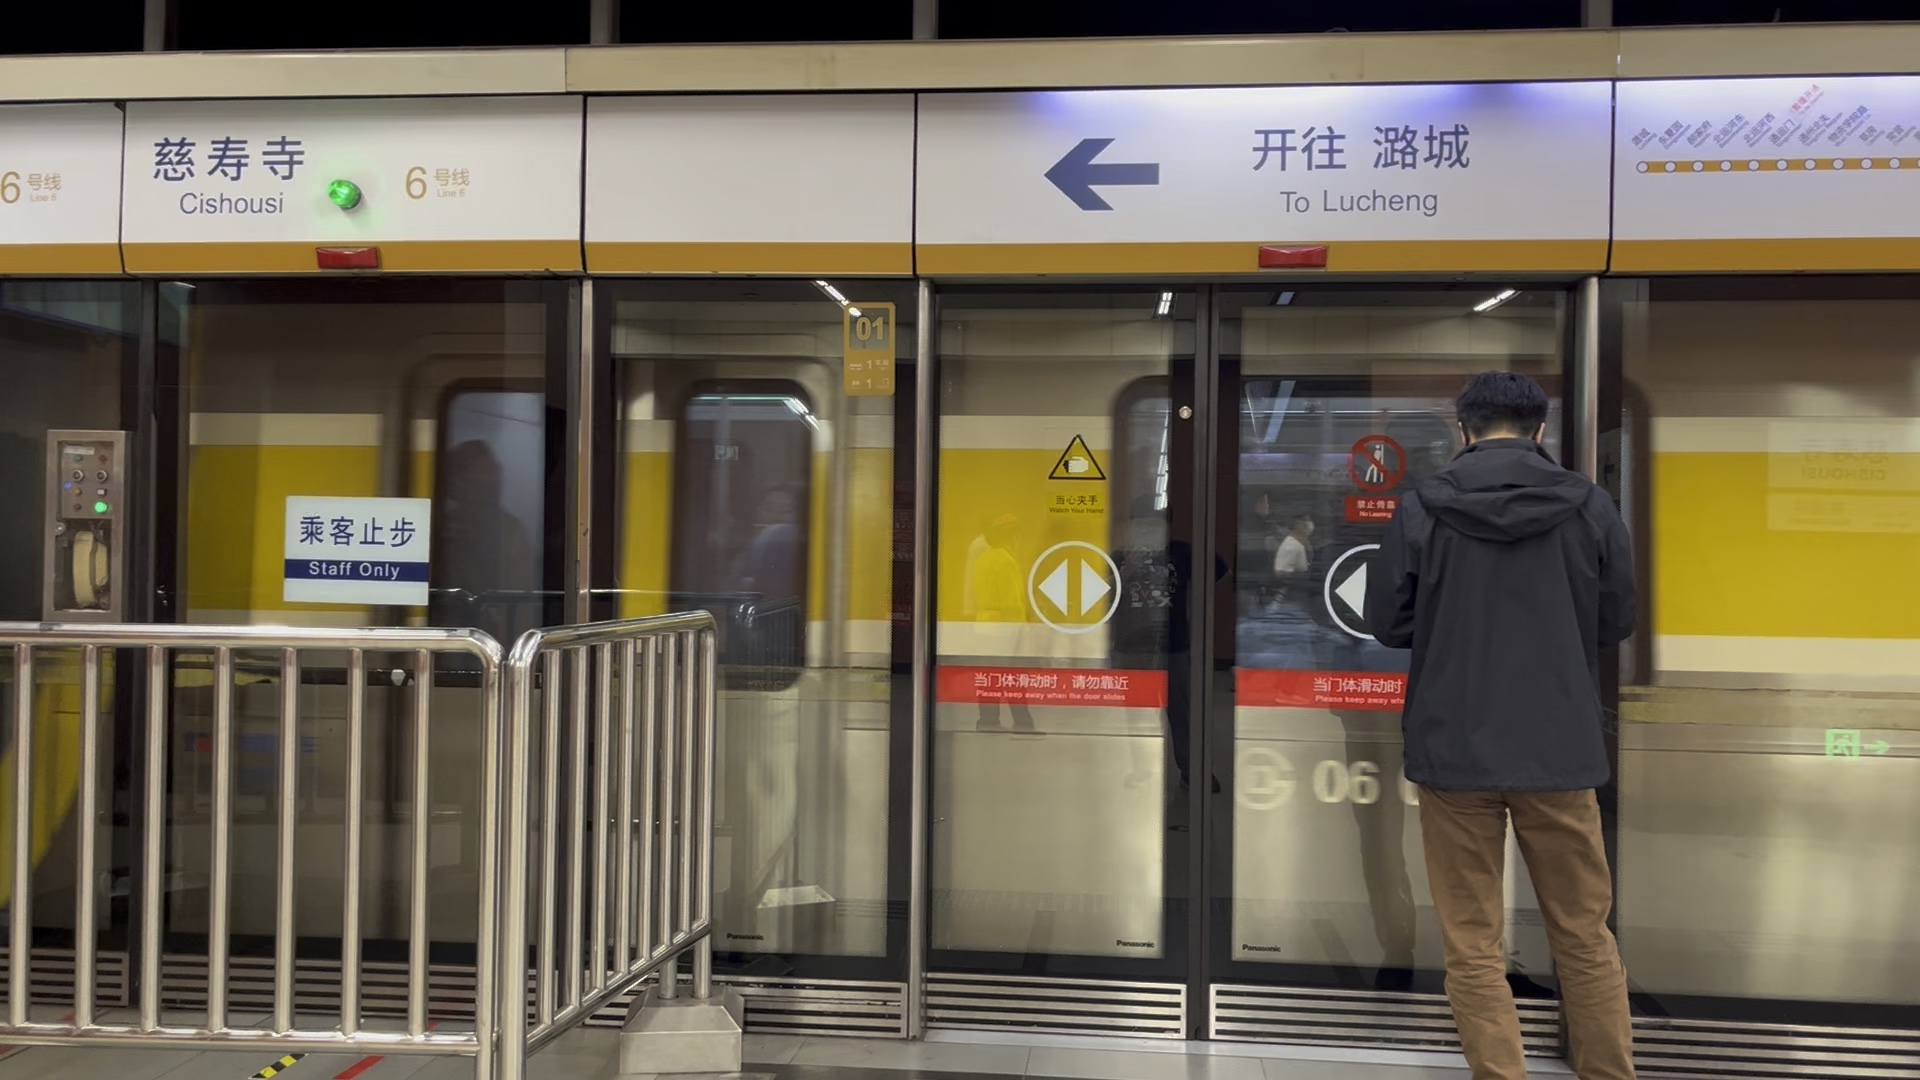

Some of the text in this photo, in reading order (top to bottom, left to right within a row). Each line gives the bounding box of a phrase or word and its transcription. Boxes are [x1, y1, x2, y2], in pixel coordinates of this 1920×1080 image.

[153, 136, 305, 182] 慈寿寺
[1252, 124, 1470, 171] 开往 潞城
[1, 171, 62, 204] 6 号线
[406, 166, 470, 200] 6 号线
[180, 191, 284, 215] Cishousi
[1280, 189, 1438, 217] To Lucheng
[856, 316, 884, 341] 01
[1056, 494, 1098, 506] 当心夹手
[299, 515, 416, 548] 乘客止步
[309, 561, 400, 580] Staff Only
[976, 689, 1001, 698] Please
[1004, 690, 1023, 699] keep
[1025, 692, 1045, 700] away
[1047, 692, 1067, 700] when
[1103, 693, 1126, 701] slides
[1313, 676, 1403, 694] 当门体滑动时
[1315, 694, 1342, 703] Please
[1345, 696, 1366, 705] keep
[1367, 697, 1389, 705] away
[1313, 759, 1381, 805] 06
[726, 932, 764, 941] Panasonic
[1116, 939, 1155, 948] Panasonic
[1242, 943, 1281, 952] Panasonic
